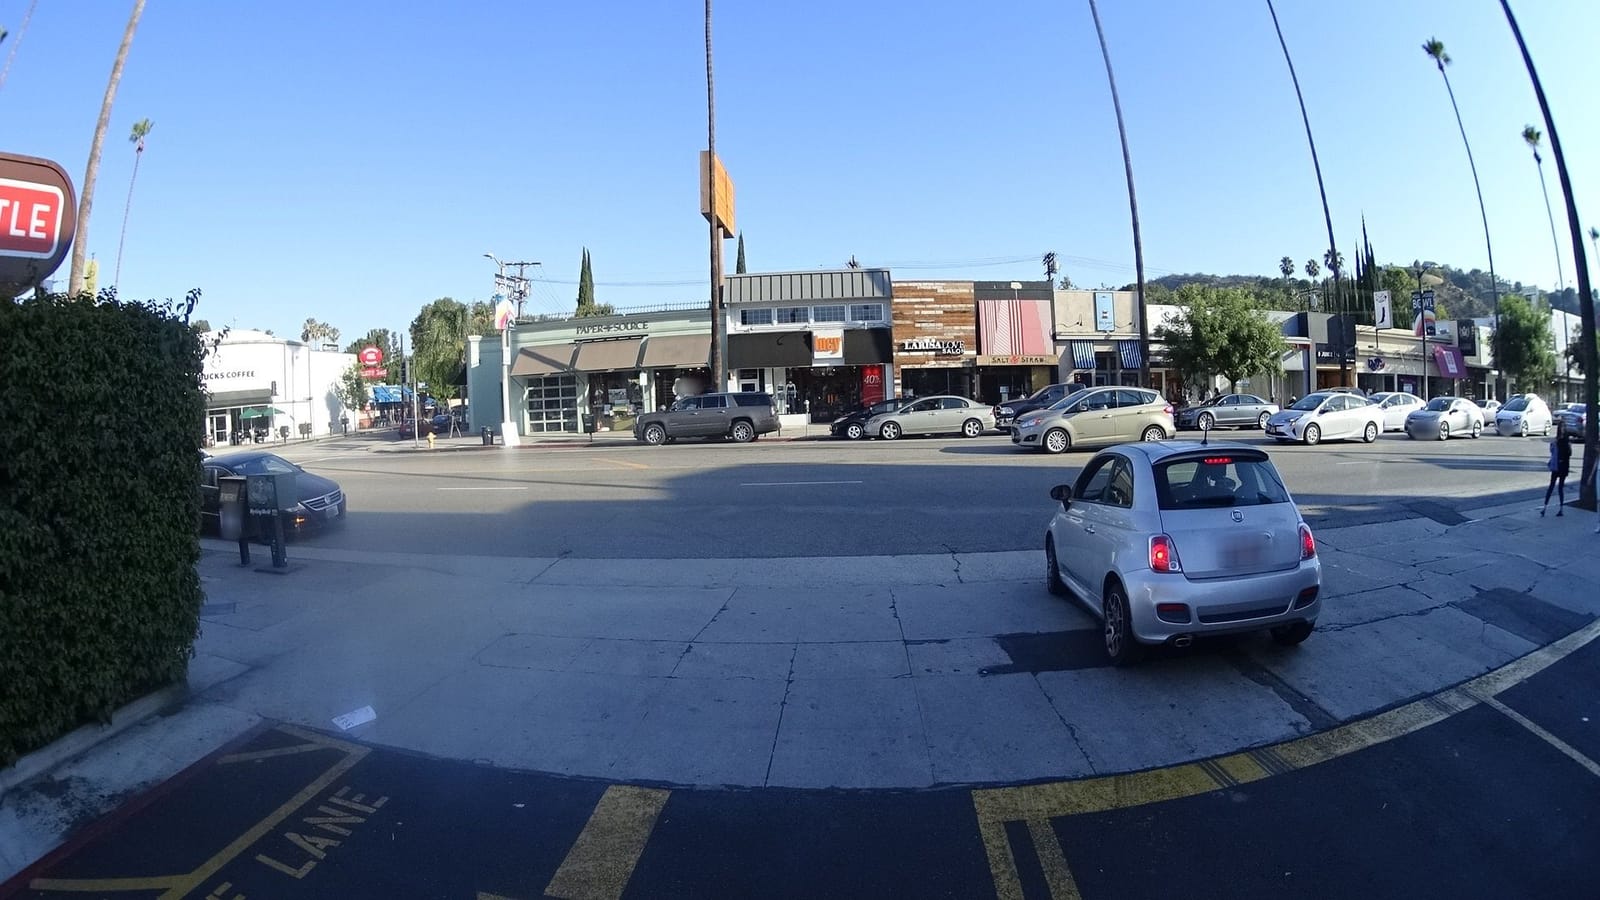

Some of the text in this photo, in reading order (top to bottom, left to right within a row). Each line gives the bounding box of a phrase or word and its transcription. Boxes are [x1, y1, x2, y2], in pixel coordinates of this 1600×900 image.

[576, 324, 603, 334] PAPER
[613, 321, 648, 332] SOURCE
[226, 370, 255, 378] COFFEE
[256, 786, 389, 880] LANE
